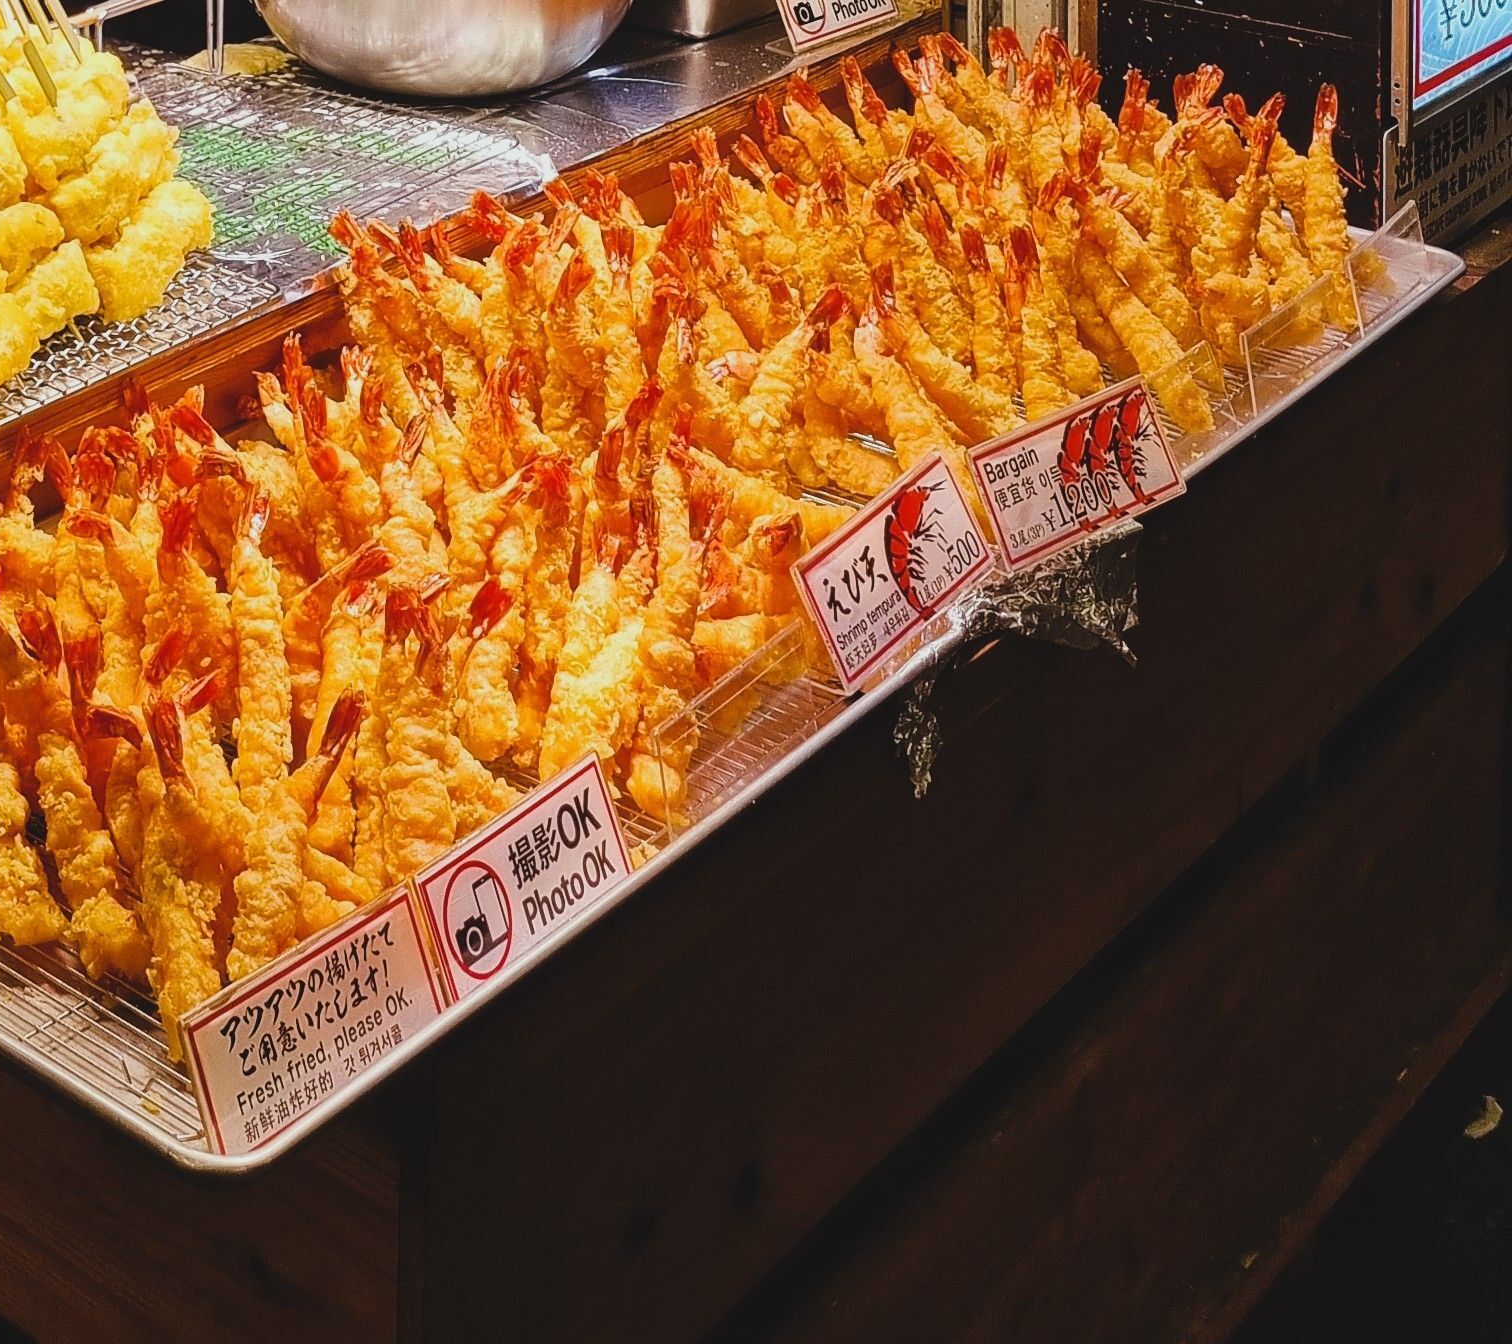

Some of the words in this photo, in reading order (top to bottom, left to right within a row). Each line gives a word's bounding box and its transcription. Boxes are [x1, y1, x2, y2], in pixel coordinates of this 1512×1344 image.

[983, 446, 1040, 485] Bargain
[994, 476, 1038, 512] 便宜货
[1041, 471, 1113, 533] ¥1,200
[823, 545, 889, 623] えび天
[943, 530, 980, 582] ¥500
[836, 618, 869, 651] Shrimp
[866, 589, 902, 627] tempura
[507, 787, 602, 890] 撮影OK
[522, 878, 585, 935] Photo
[583, 839, 617, 892] OK
[237, 1074, 285, 1116] Fresh
[287, 1047, 333, 1084] fried,
[333, 1011, 384, 1058] please
[385, 994, 413, 1020] OK.
[343, 1054, 358, 1079] 갓
[244, 1069, 334, 1144] 新鲜油炸好的
